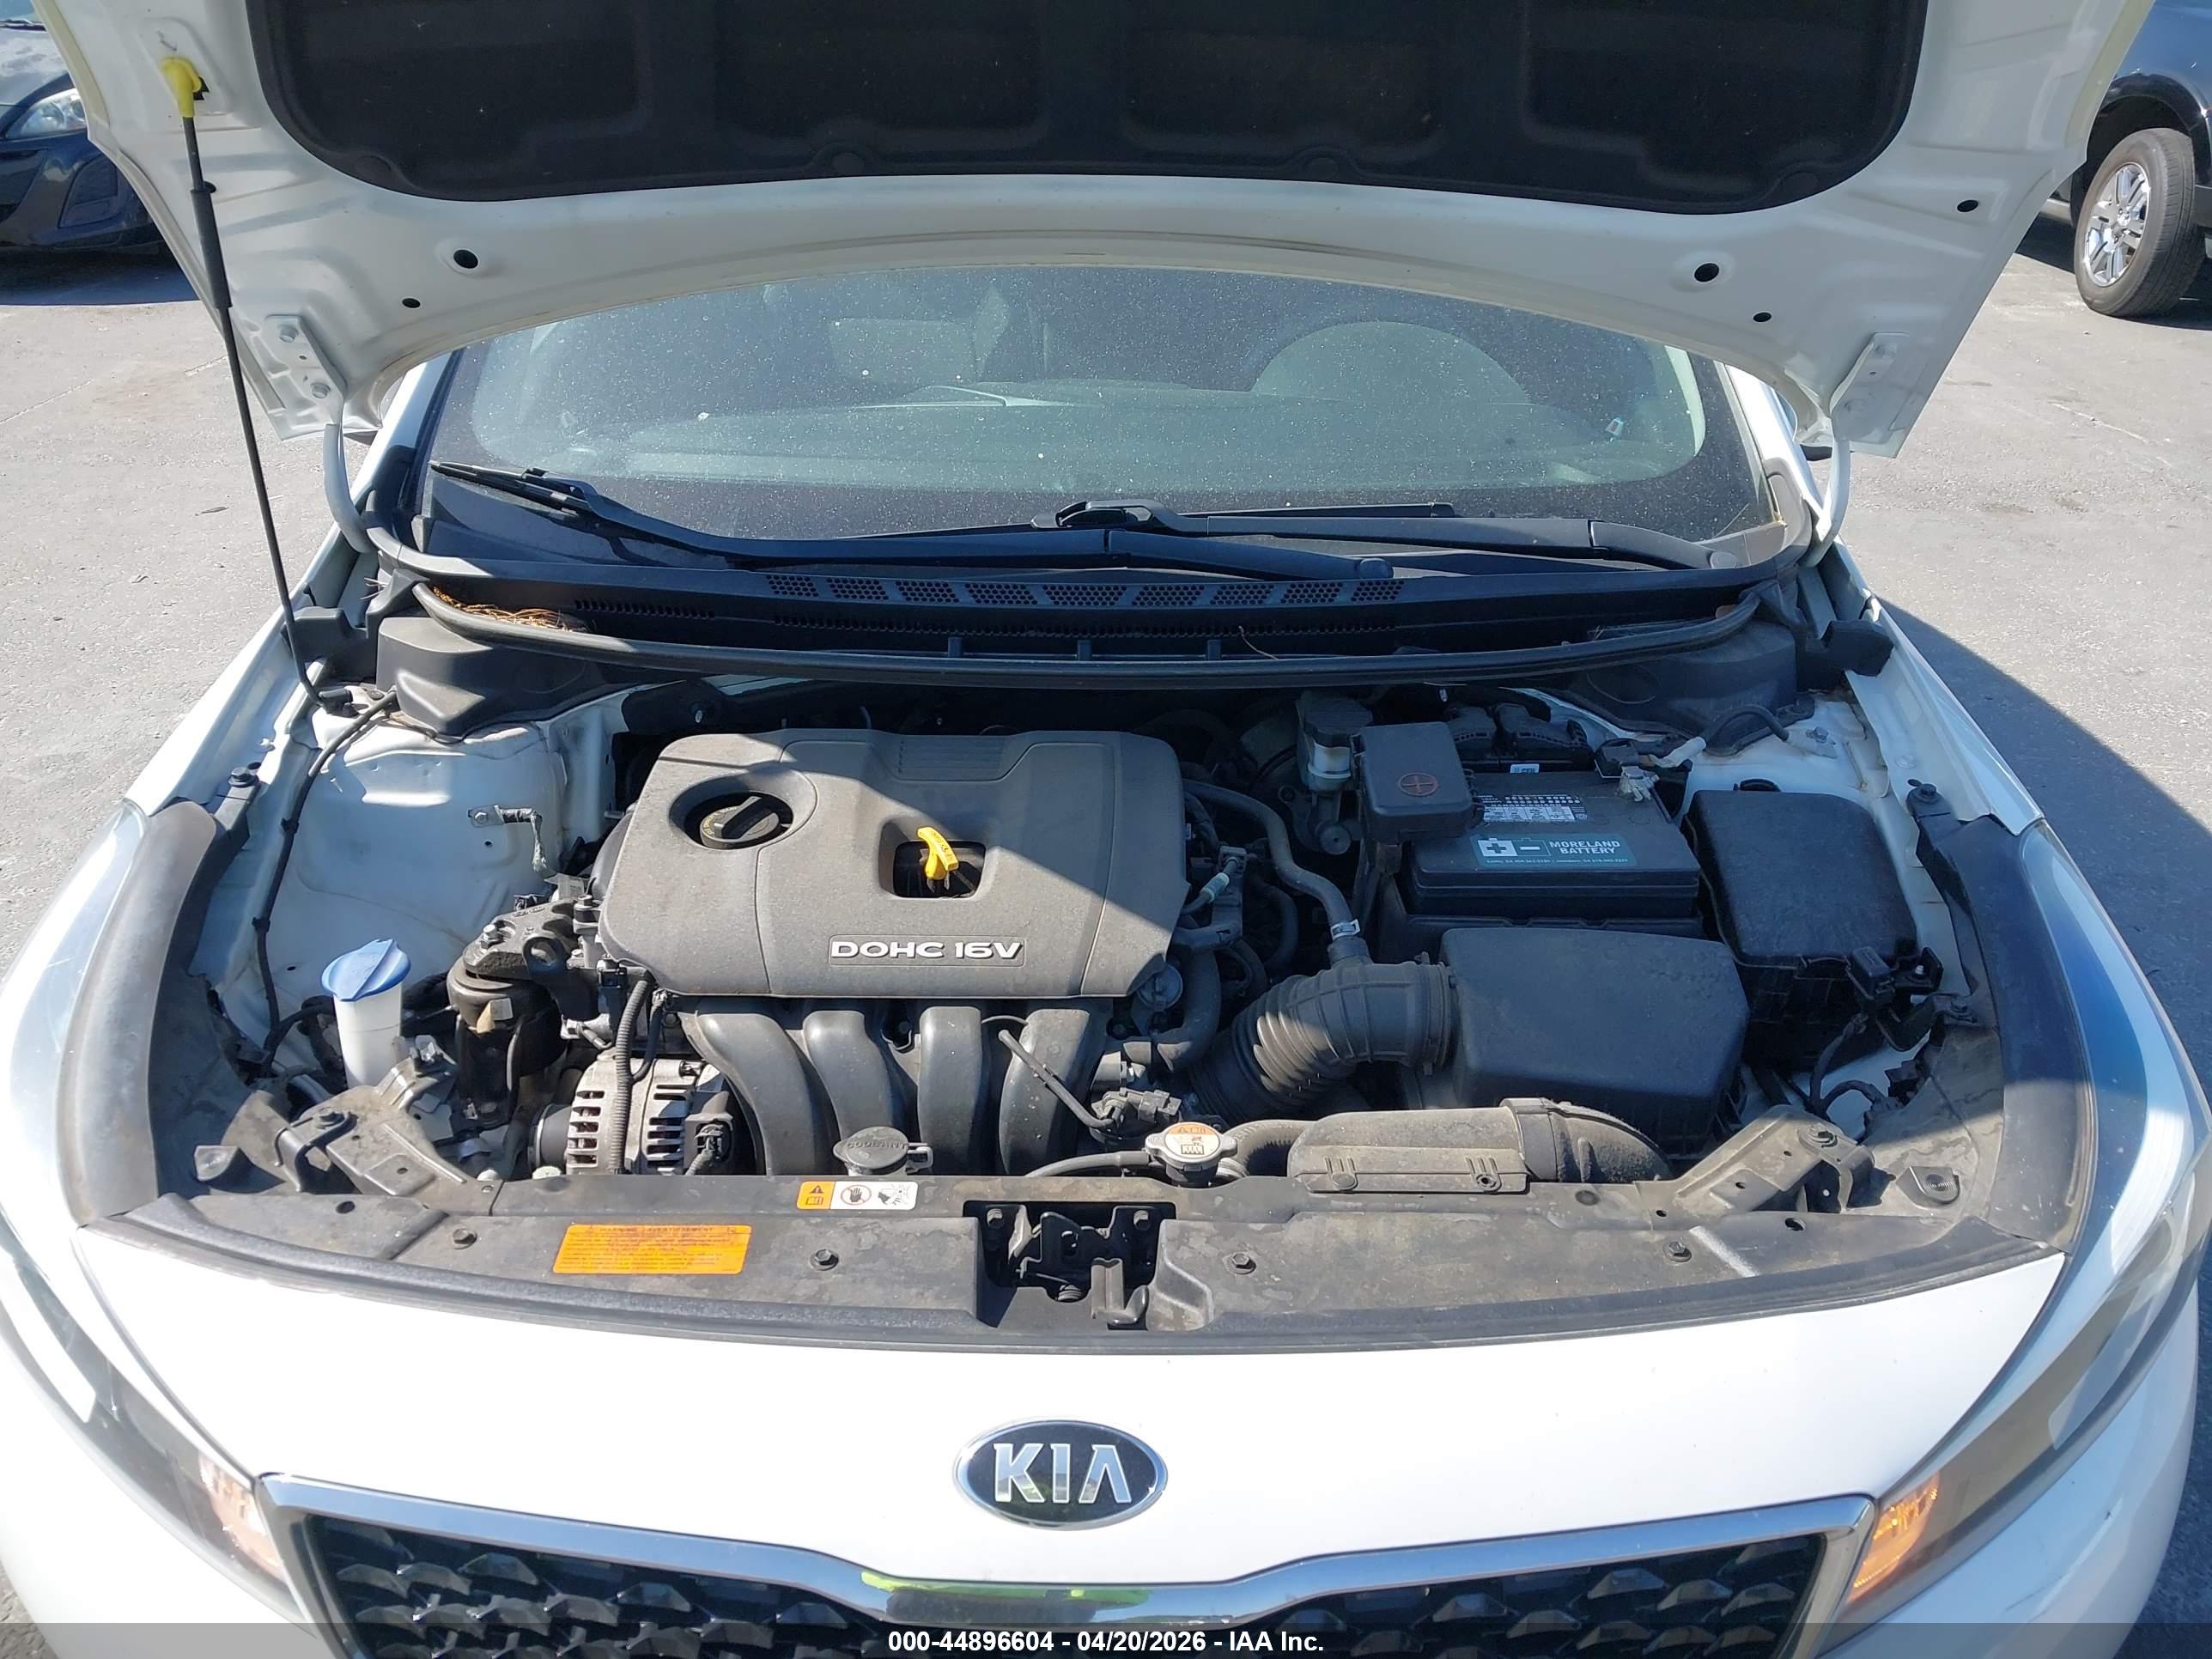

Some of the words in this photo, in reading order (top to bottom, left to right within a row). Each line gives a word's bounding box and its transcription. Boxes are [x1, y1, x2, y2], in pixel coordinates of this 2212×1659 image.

[830, 941, 945, 958] DOHC
[955, 942, 1023, 959] 16V
[847, 1140, 908, 1149] COOLANT
[994, 1443, 1133, 1504] KIA
